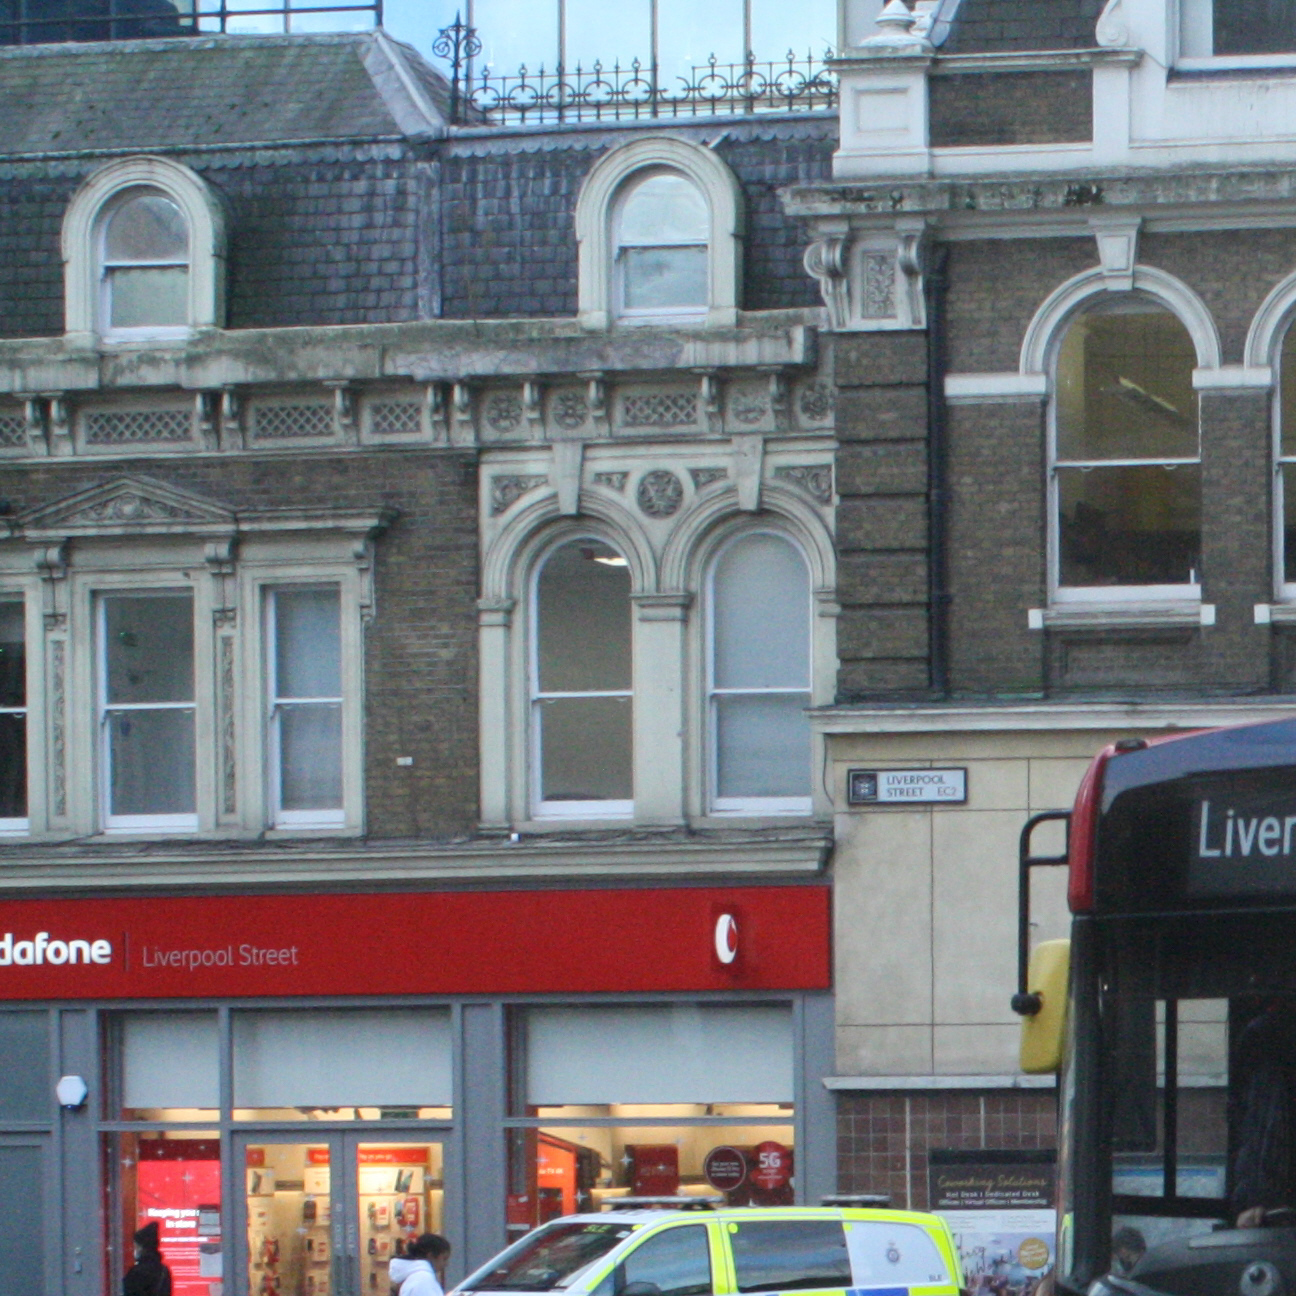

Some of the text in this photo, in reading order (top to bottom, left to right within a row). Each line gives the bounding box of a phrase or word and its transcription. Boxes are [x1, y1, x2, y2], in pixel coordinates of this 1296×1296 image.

[886, 775, 946, 785] LIVERPOOL
[886, 786, 957, 797] STREET EC2
[143, 944, 298, 971] Liverpool Street
[759, 1152, 781, 1168] 5G
